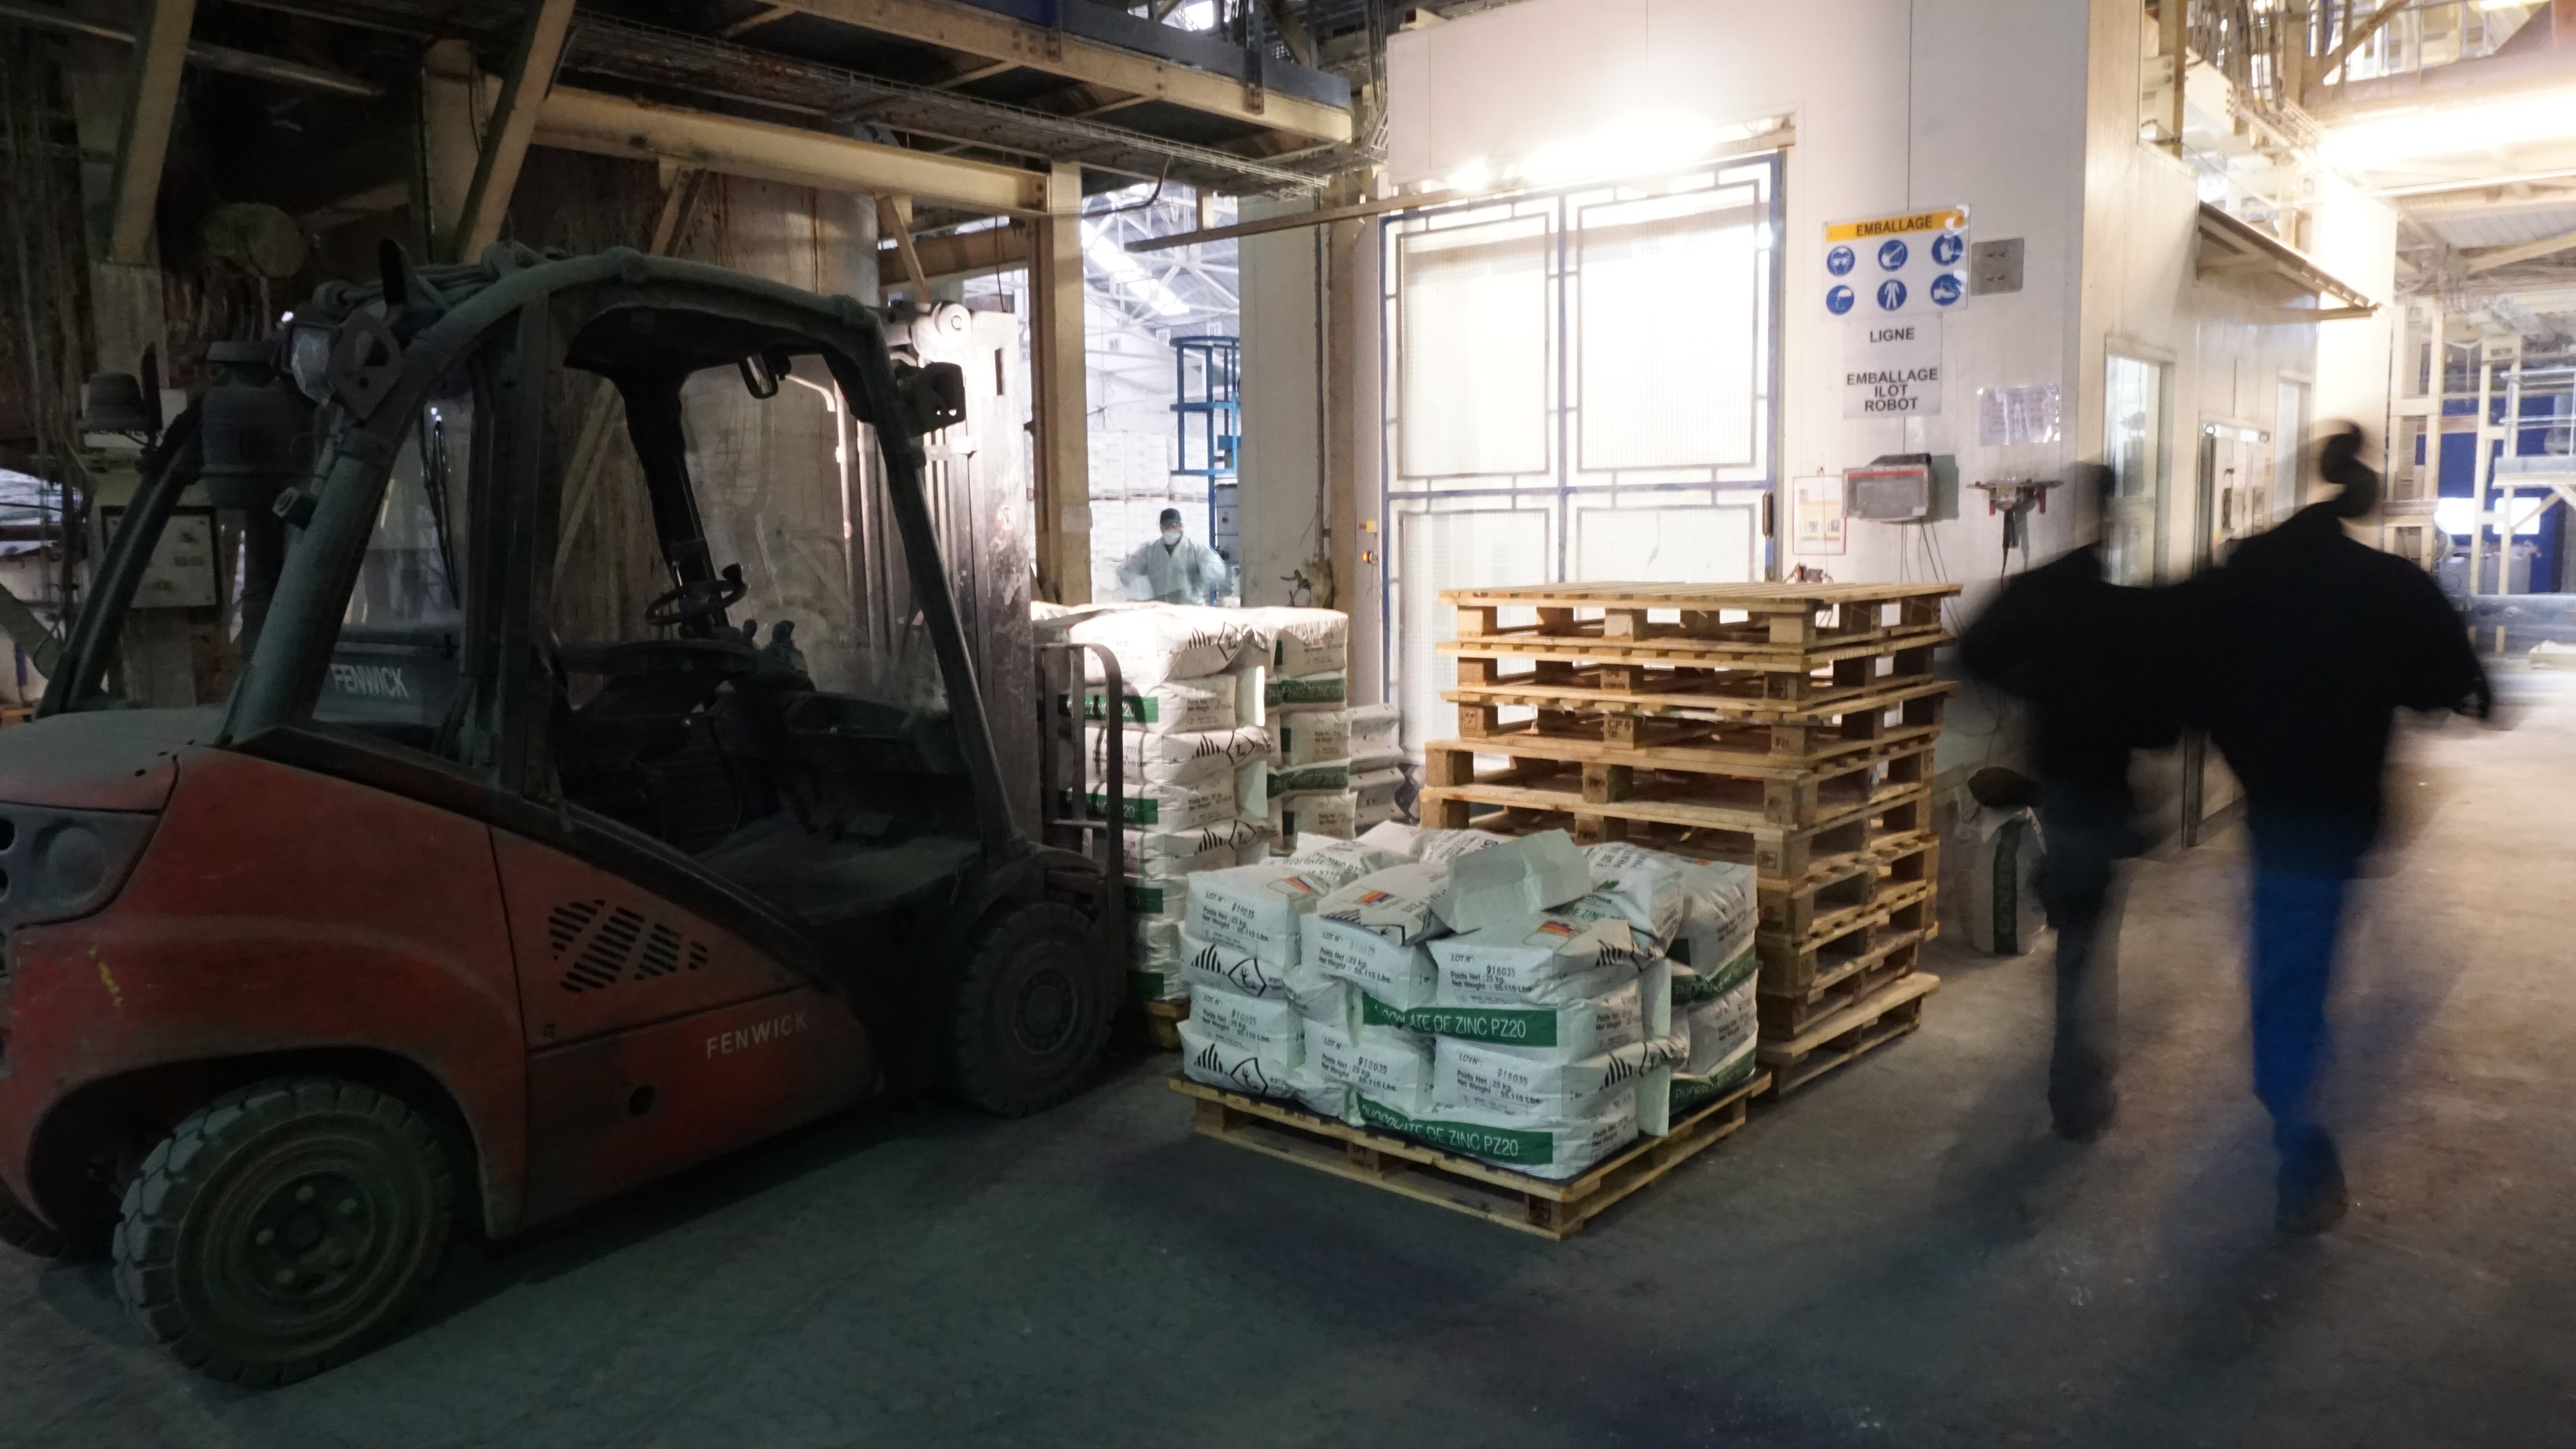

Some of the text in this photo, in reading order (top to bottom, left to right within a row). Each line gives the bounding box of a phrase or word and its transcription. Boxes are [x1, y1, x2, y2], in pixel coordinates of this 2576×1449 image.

[1856, 215, 1932, 236] EMBALLAGE
[1870, 327, 1915, 343] LIGNE
[1847, 368, 1938, 385] EMBALLAGE
[1874, 384, 1908, 398] ILOT
[1865, 397, 1918, 412] ROBOT
[330, 663, 409, 699] FENWICK
[1322, 931, 1333, 941] LOT
[1451, 954, 1463, 962] LOT
[1450, 971, 1467, 980] Poids
[1469, 973, 1481, 982] Net
[1452, 979, 1462, 988] Net
[1434, 1015, 1452, 1031] DE
[1455, 1016, 1487, 1036] ZINC
[1491, 1018, 1526, 1038] PZ20
[706, 1010, 808, 1060] FENWICK
[1324, 1037, 1335, 1047] LOT
[1459, 1053, 1472, 1063] LOT
[1457, 1067, 1474, 1081] Poids
[1475, 1076, 1487, 1085] Net
[1457, 1079, 1467, 1088] Net
[1448, 1129, 1480, 1151] ZINC
[1484, 1135, 1519, 1157] PZ20
